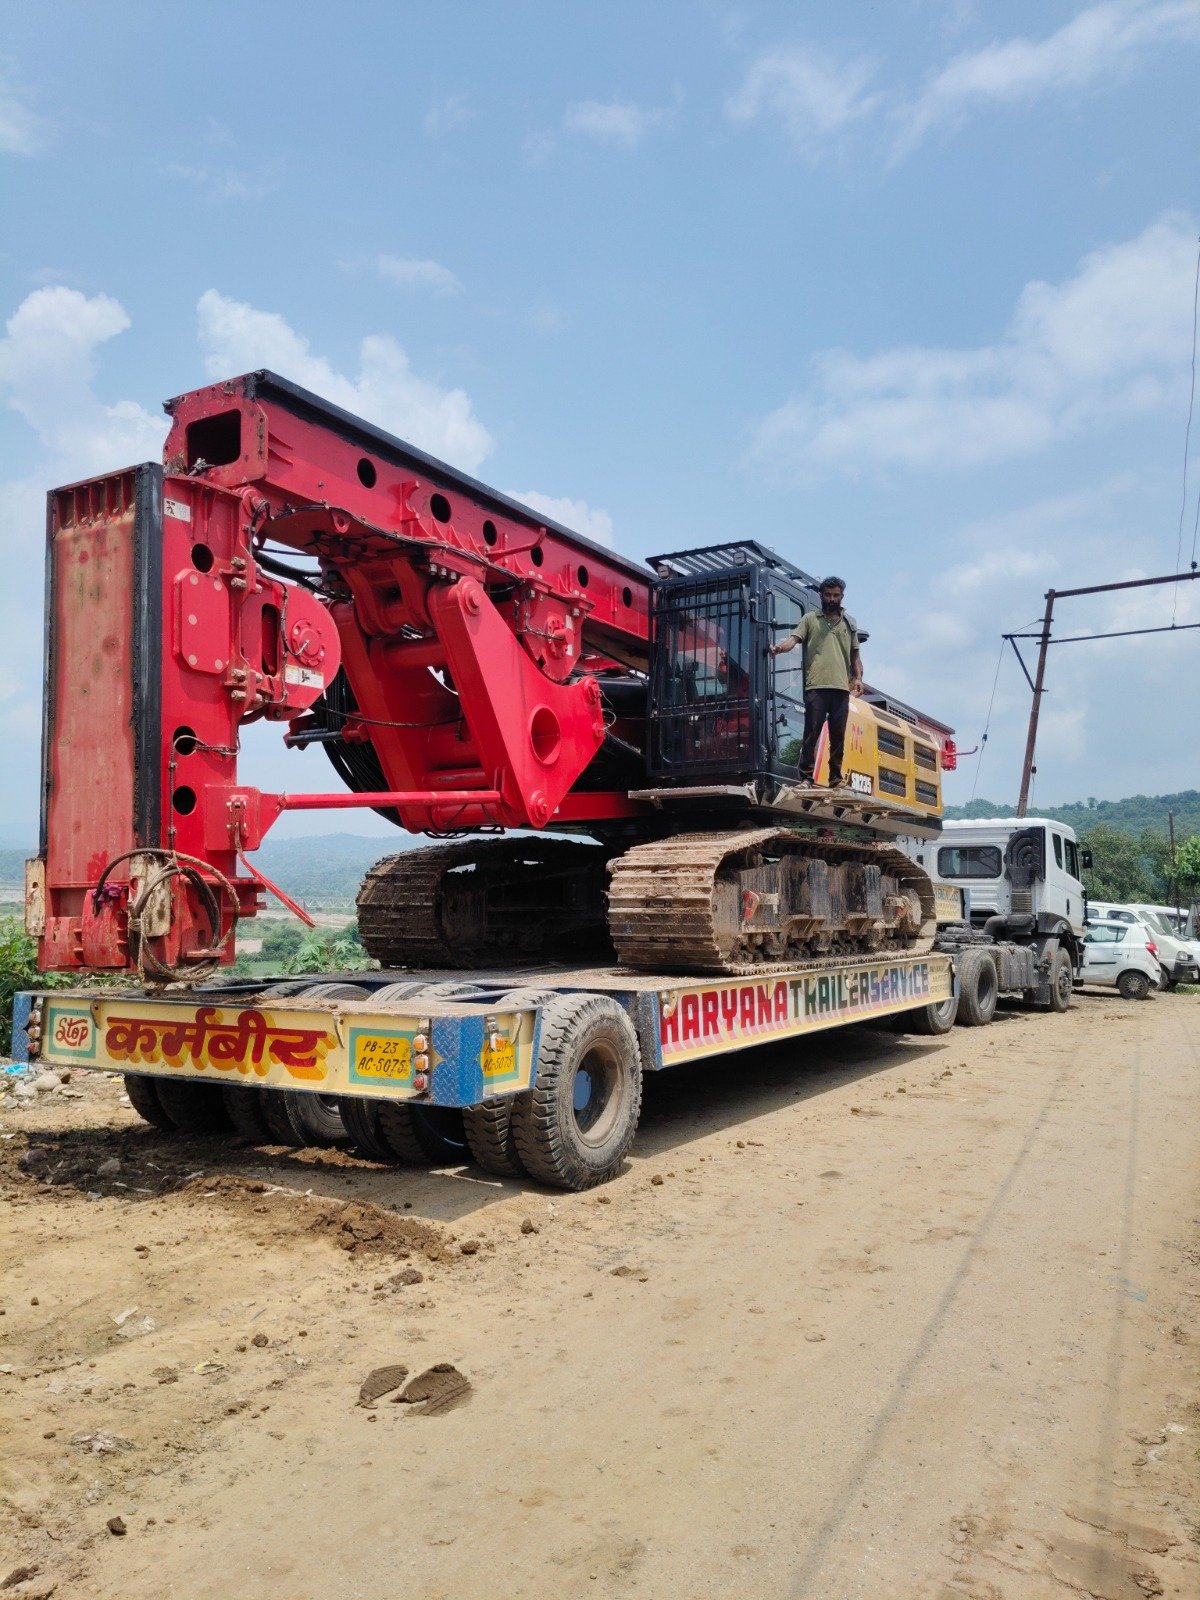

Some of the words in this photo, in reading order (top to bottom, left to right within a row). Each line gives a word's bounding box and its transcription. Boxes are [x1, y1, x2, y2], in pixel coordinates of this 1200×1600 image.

[660, 981, 788, 1046] HARYANA
[789, 972, 870, 1019] TRAILER
[870, 963, 929, 1001] SERVICE
[55, 1017, 89, 1047] Stop
[363, 1040, 400, 1054] PB-23
